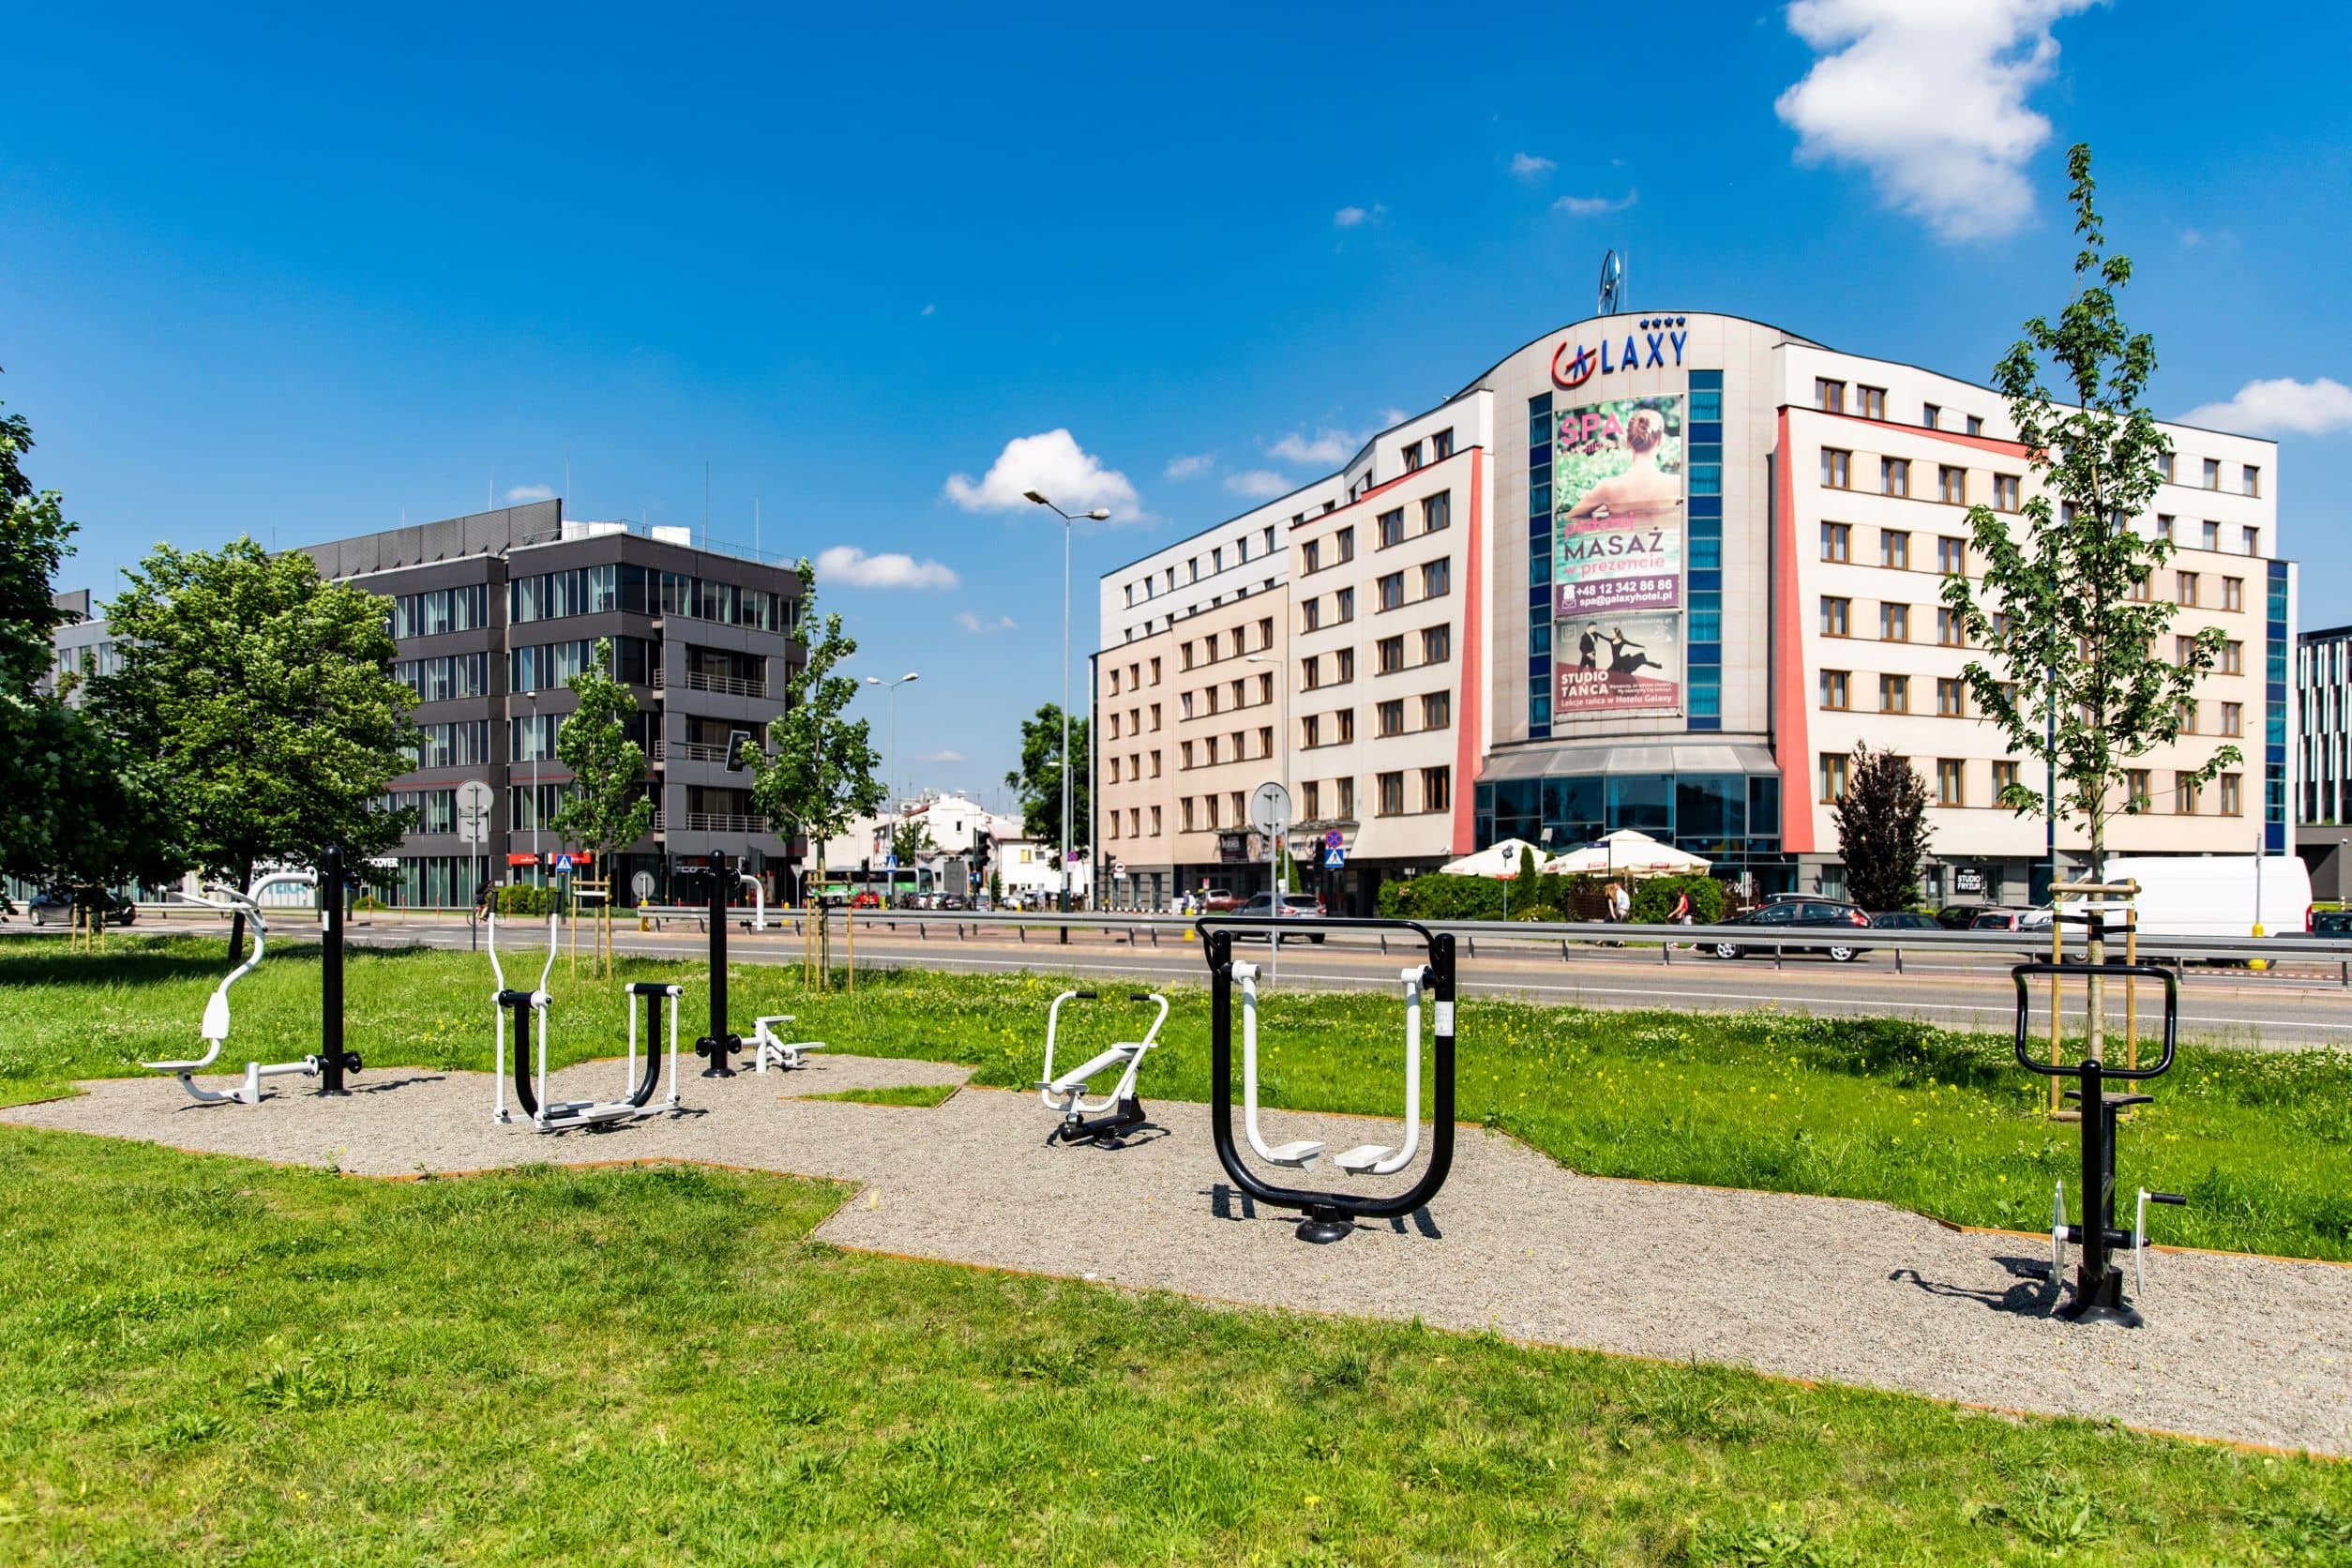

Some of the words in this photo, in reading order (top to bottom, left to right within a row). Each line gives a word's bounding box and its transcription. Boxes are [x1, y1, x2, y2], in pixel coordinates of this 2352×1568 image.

[1552, 330, 1687, 387] GALAXY
[1560, 412, 1624, 445] SPA
[1564, 526, 1664, 562] MASAŻ
[1564, 565, 1576, 574] w
[1581, 555, 1666, 579] prezencie
[1576, 584, 1596, 596] +48
[1599, 583, 1612, 594] 12
[1615, 581, 1636, 593] 342
[1639, 580, 1654, 591] 86
[1657, 579, 1672, 590] 86
[1579, 591, 1672, 608] spa@galaxyhotel.pl
[1560, 671, 1608, 685] STUDIO
[1561, 682, 1608, 698] TAŃCA
[1560, 698, 1583, 707] Lekcje
[1616, 695, 1643, 703] Hotelu
[1645, 693, 1672, 704] Galaxy
[1957, 874, 1982, 882] STUDIO
